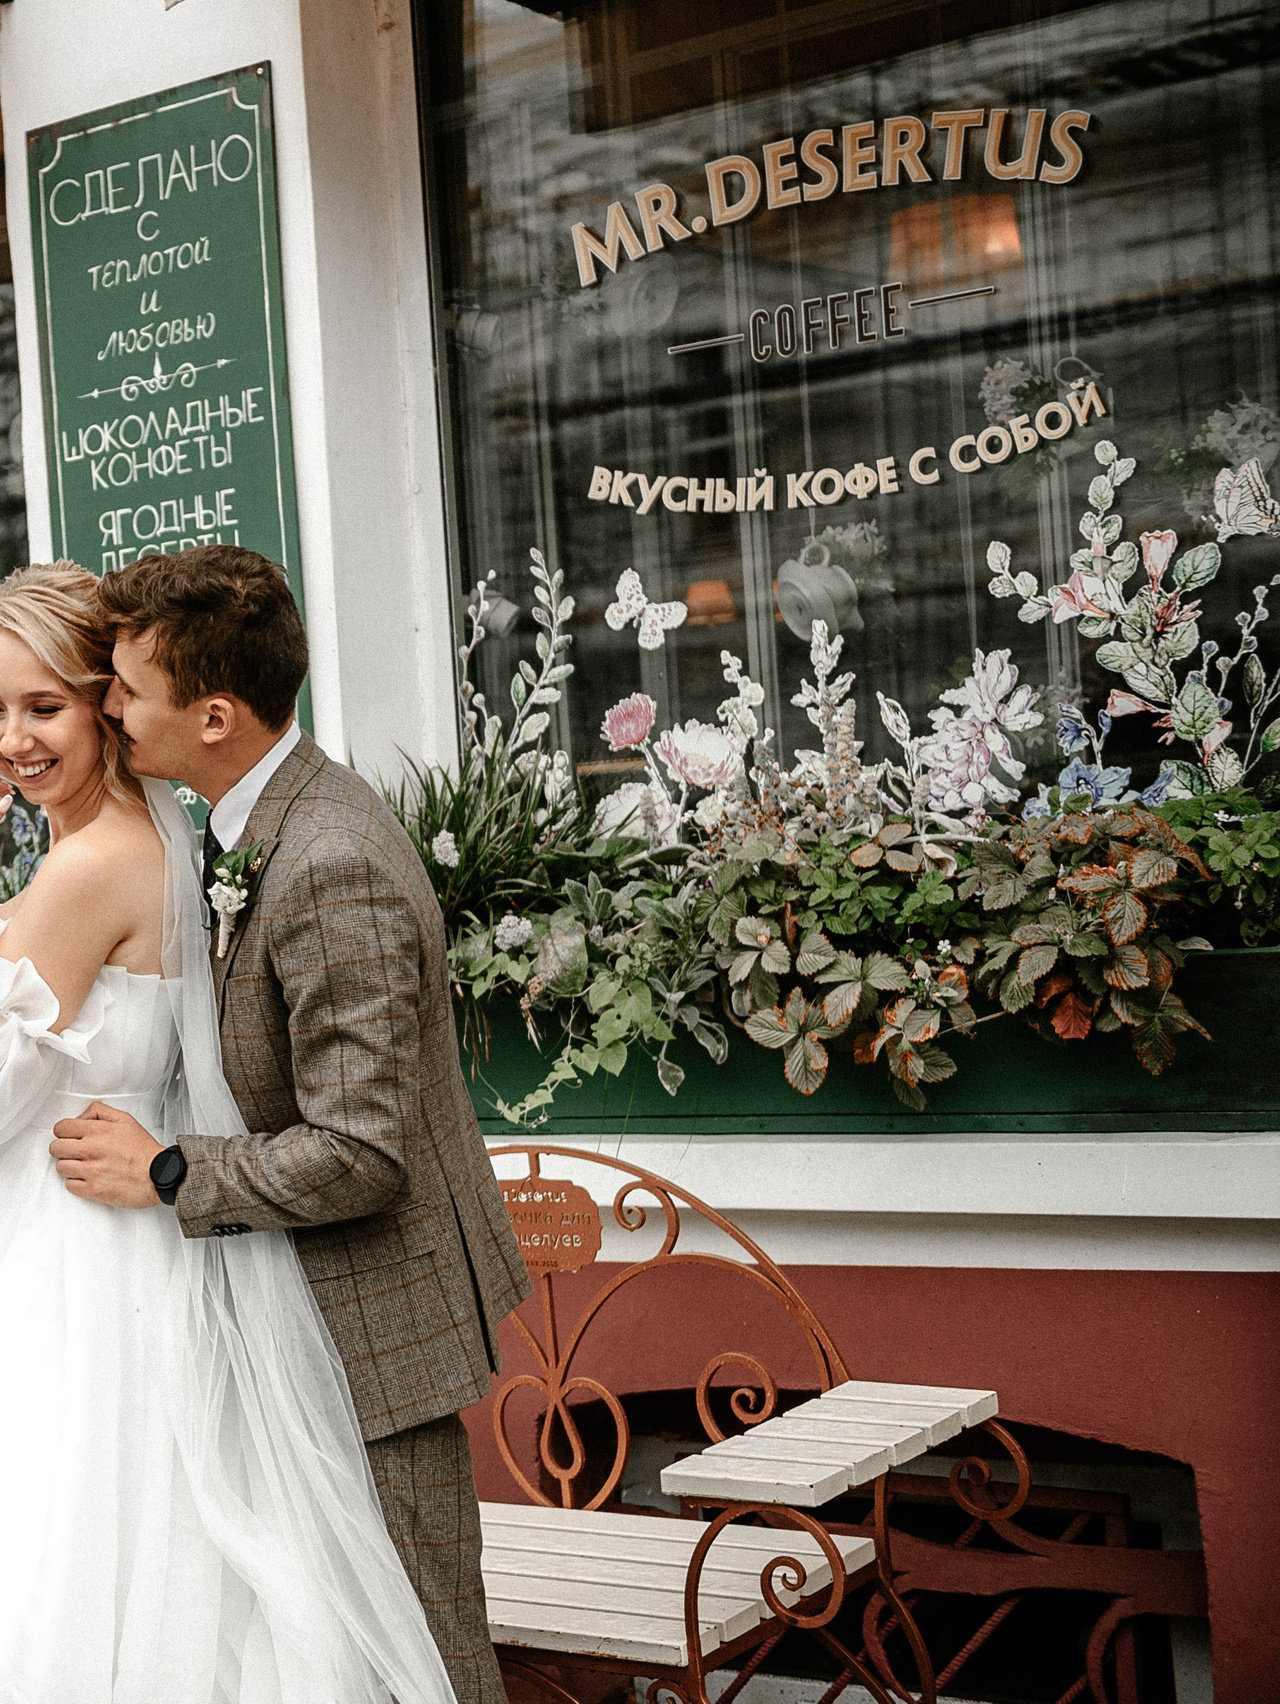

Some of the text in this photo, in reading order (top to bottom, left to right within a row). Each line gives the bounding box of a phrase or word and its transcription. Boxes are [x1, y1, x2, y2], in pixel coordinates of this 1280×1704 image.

[49, 133, 253, 226] СДЕЛАНО
[748, 282, 905, 362] COFFEE
[62, 387, 265, 462] ШОКОЛАДНЫЕ
[588, 378, 1108, 514] ВКУСНЫЙ КОФЕ С СОБОЙ
[91, 430, 232, 491] КОНФЕТЫ
[98, 487, 239, 547] ЯГОДНЫЕ
[510, 1210, 592, 1228] очка для
[516, 1232, 583, 1250] целуев
